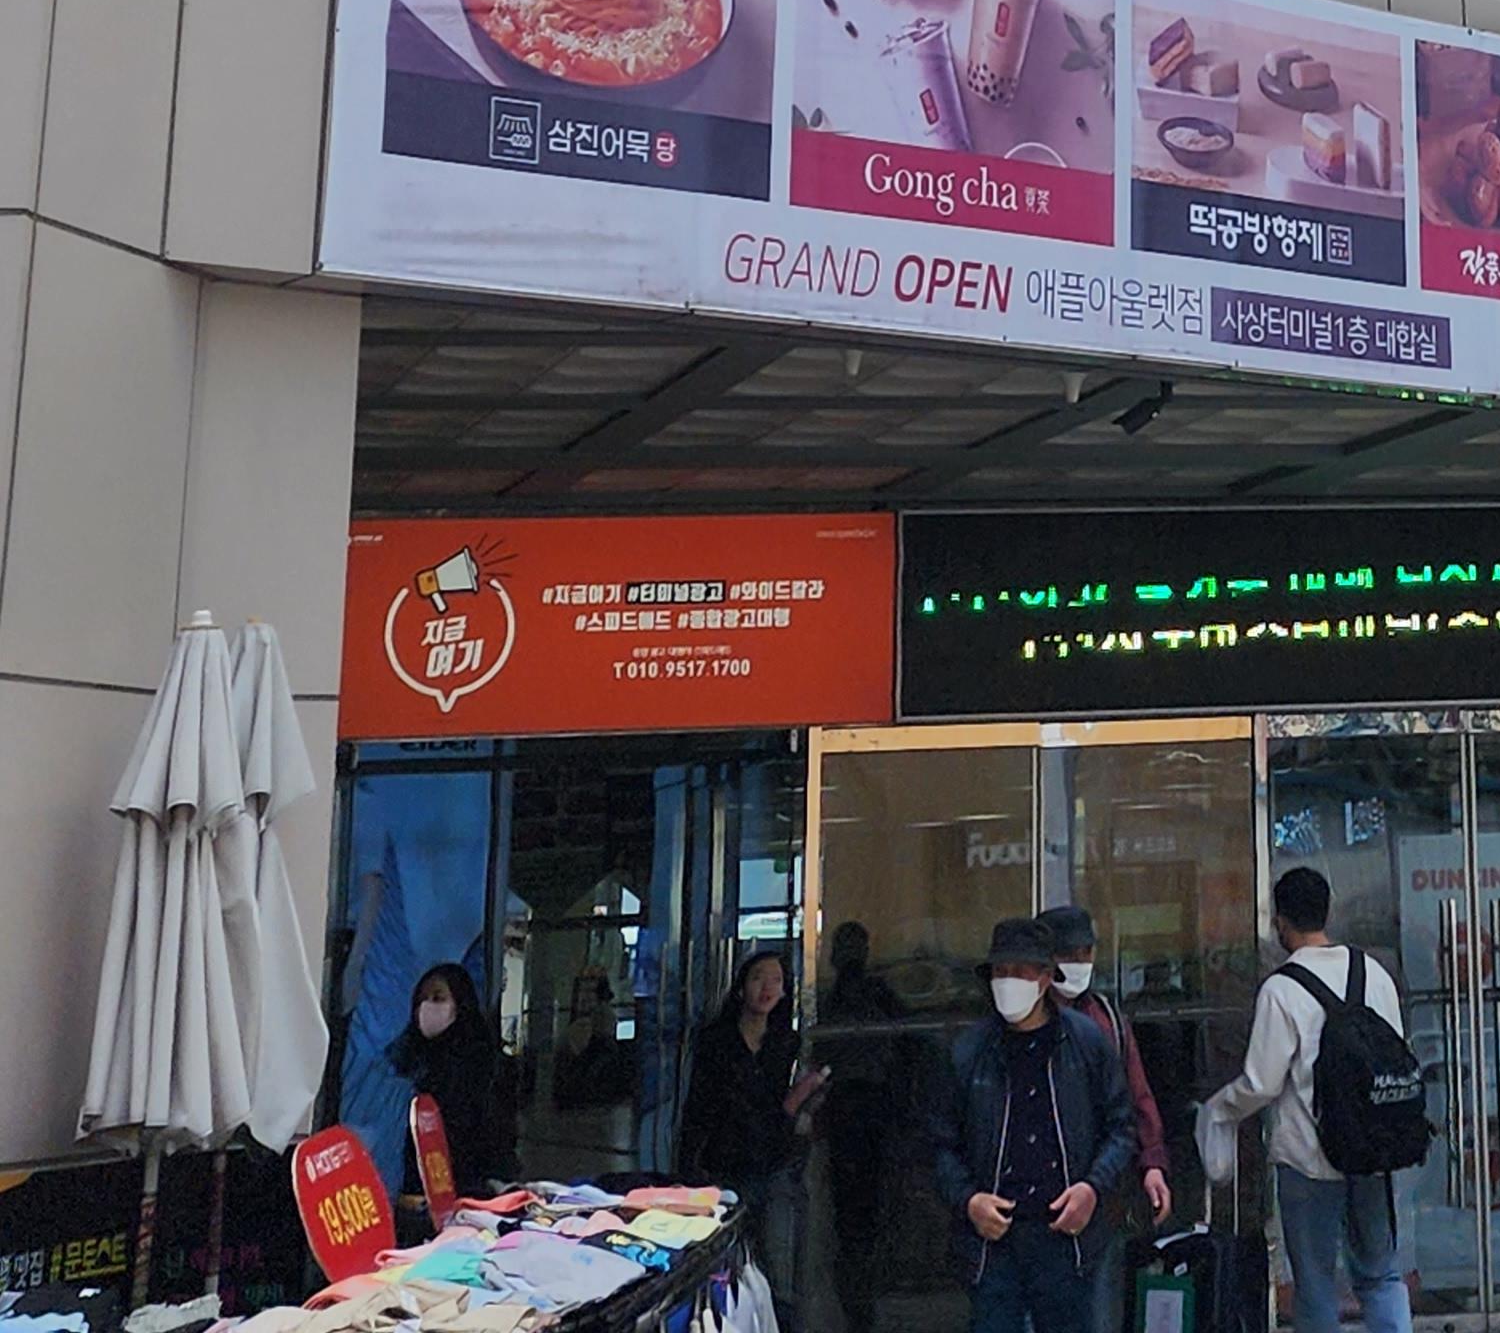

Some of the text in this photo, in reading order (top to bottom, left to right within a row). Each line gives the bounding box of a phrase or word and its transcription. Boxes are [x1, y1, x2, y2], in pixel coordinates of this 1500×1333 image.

[865, 153, 1018, 215] Gong cha
[1190, 202, 1323, 261] 떡공방형제
[724, 233, 1203, 336] GRAND OPEN 애플아울렛점
[1376, 318, 1437, 363] 대합실
[542, 584, 621, 604] #지금여기
[421, 615, 467, 646] 지금
[425, 639, 485, 678] 여기
[614, 659, 751, 679] T 010.9517.1700
